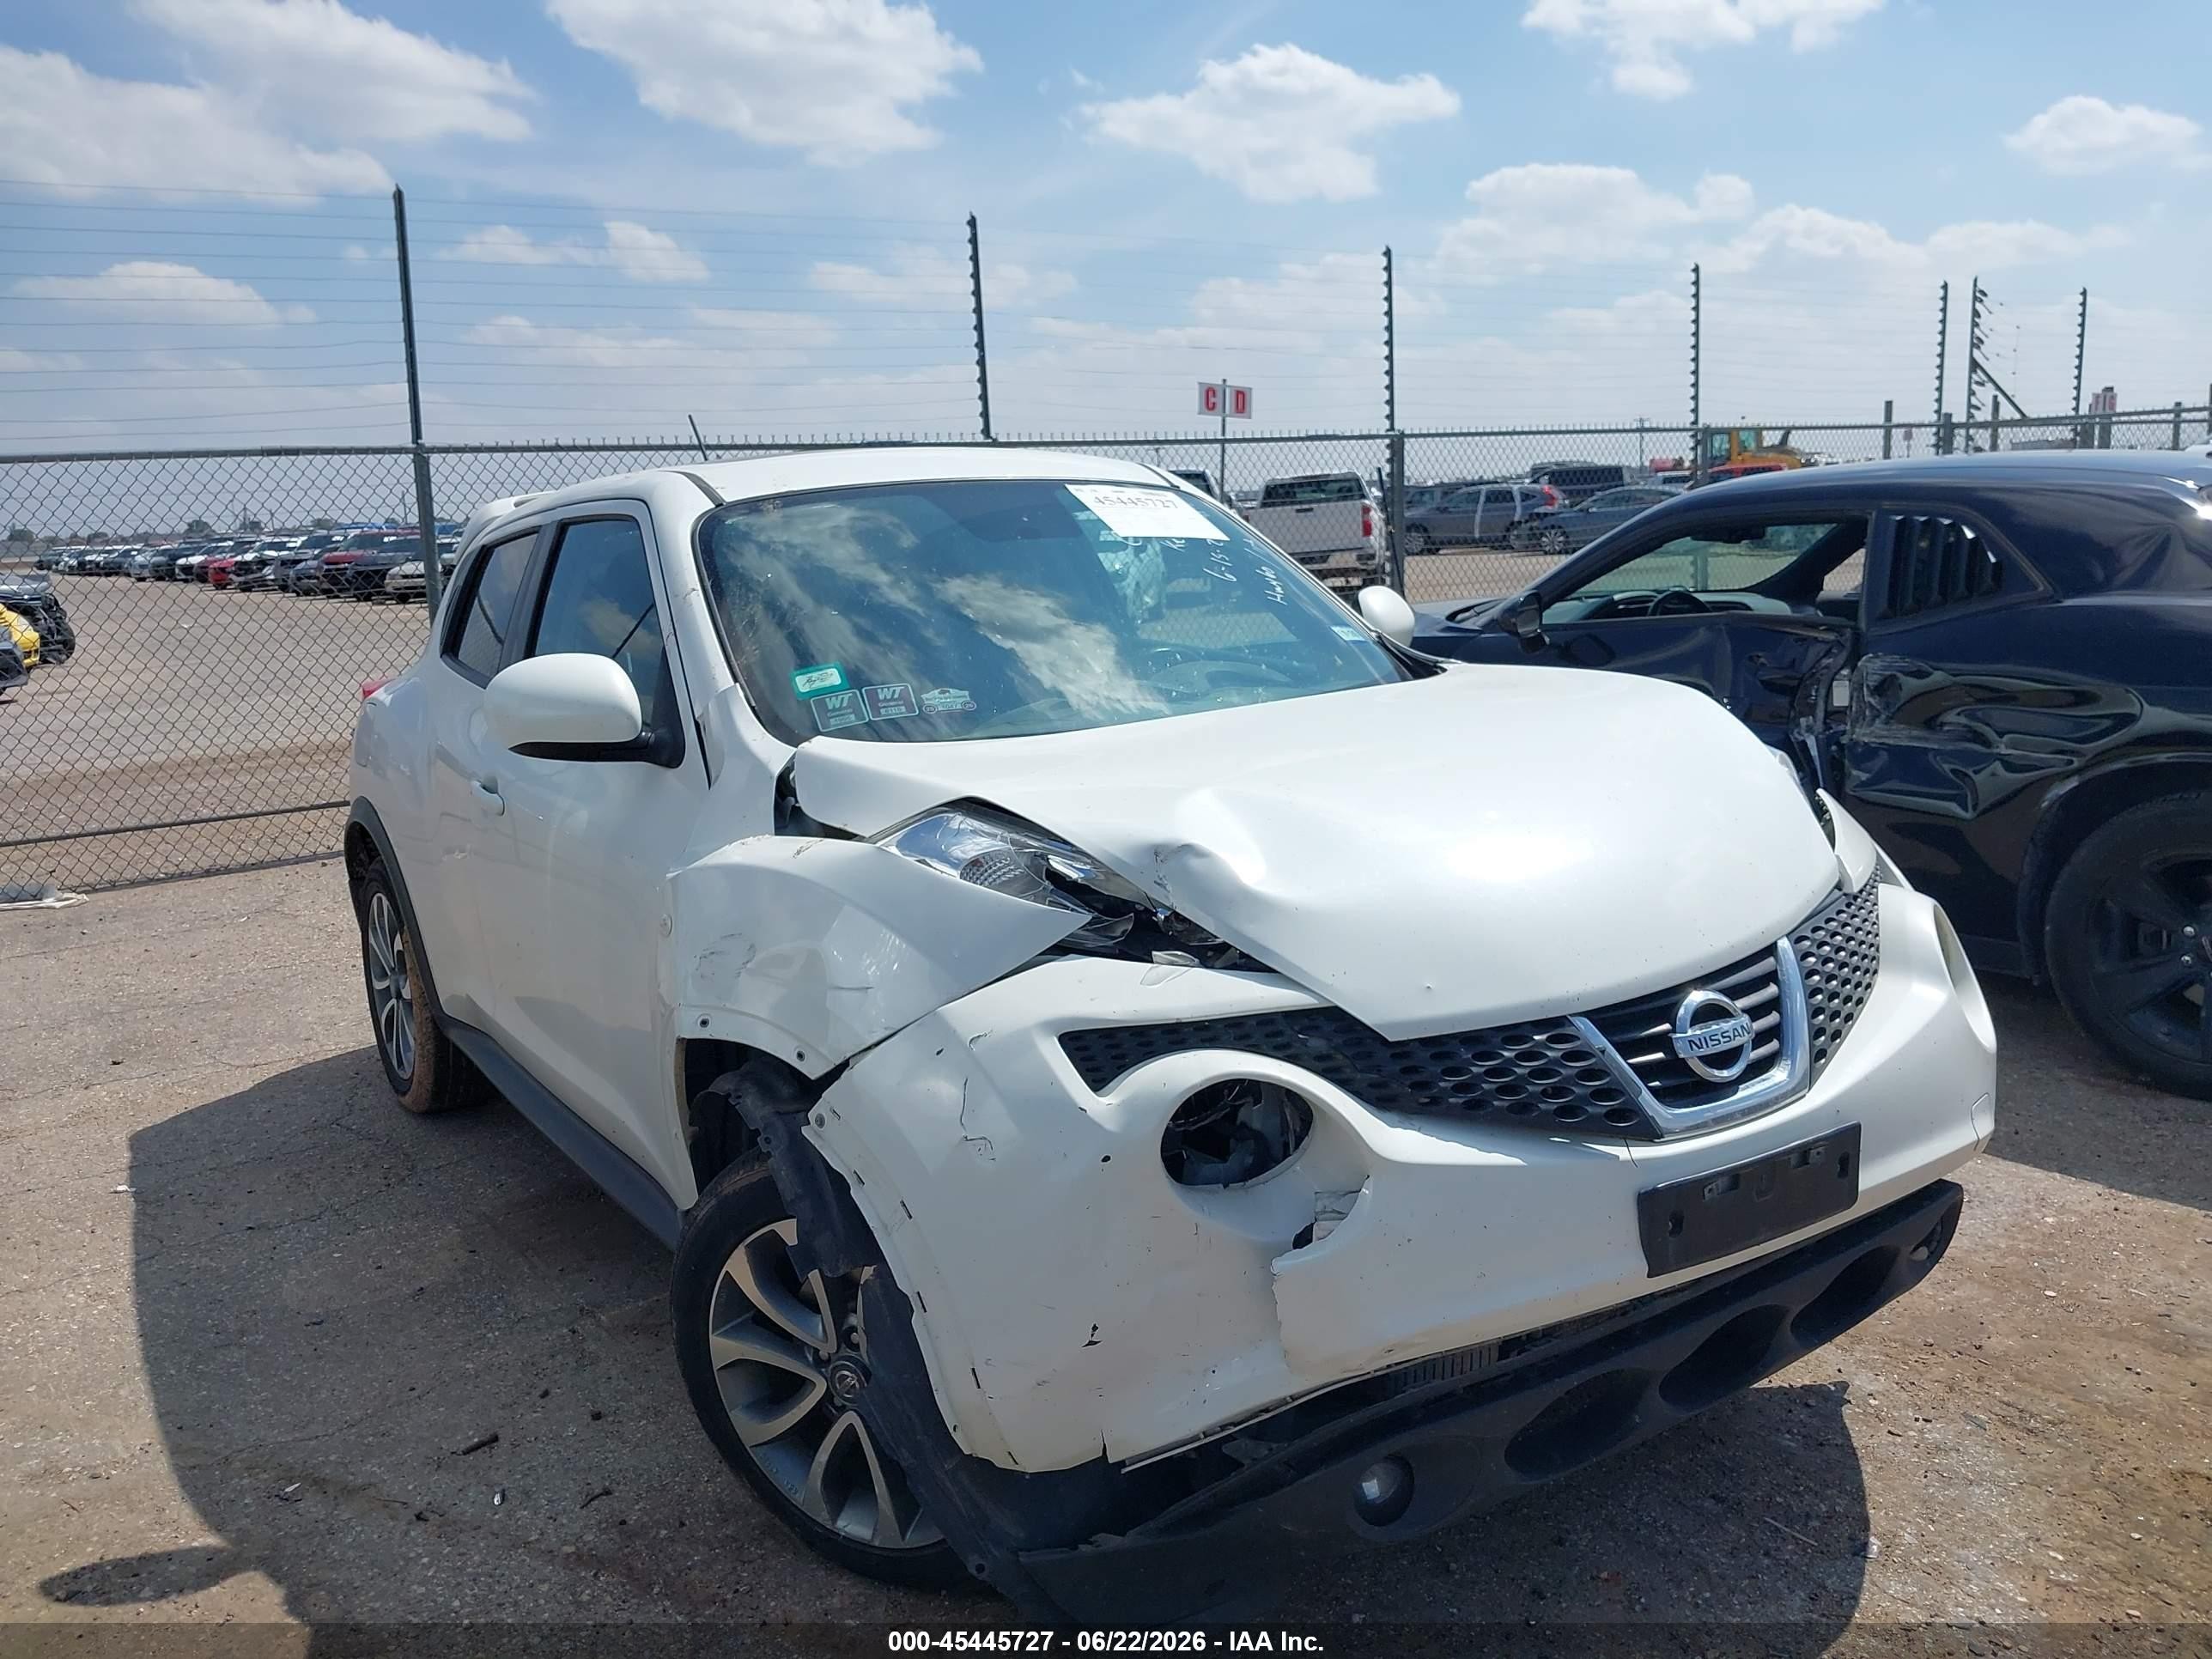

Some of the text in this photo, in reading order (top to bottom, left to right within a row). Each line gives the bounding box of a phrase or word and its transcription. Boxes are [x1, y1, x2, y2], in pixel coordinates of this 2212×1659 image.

[1205, 386, 1217, 412] C
[1235, 390, 1246, 414] D
[1094, 495, 1178, 509] 45445727
[824, 693, 853, 710] WT
[877, 686, 905, 701] WT
[1687, 1022, 1752, 1052] NISSAN
